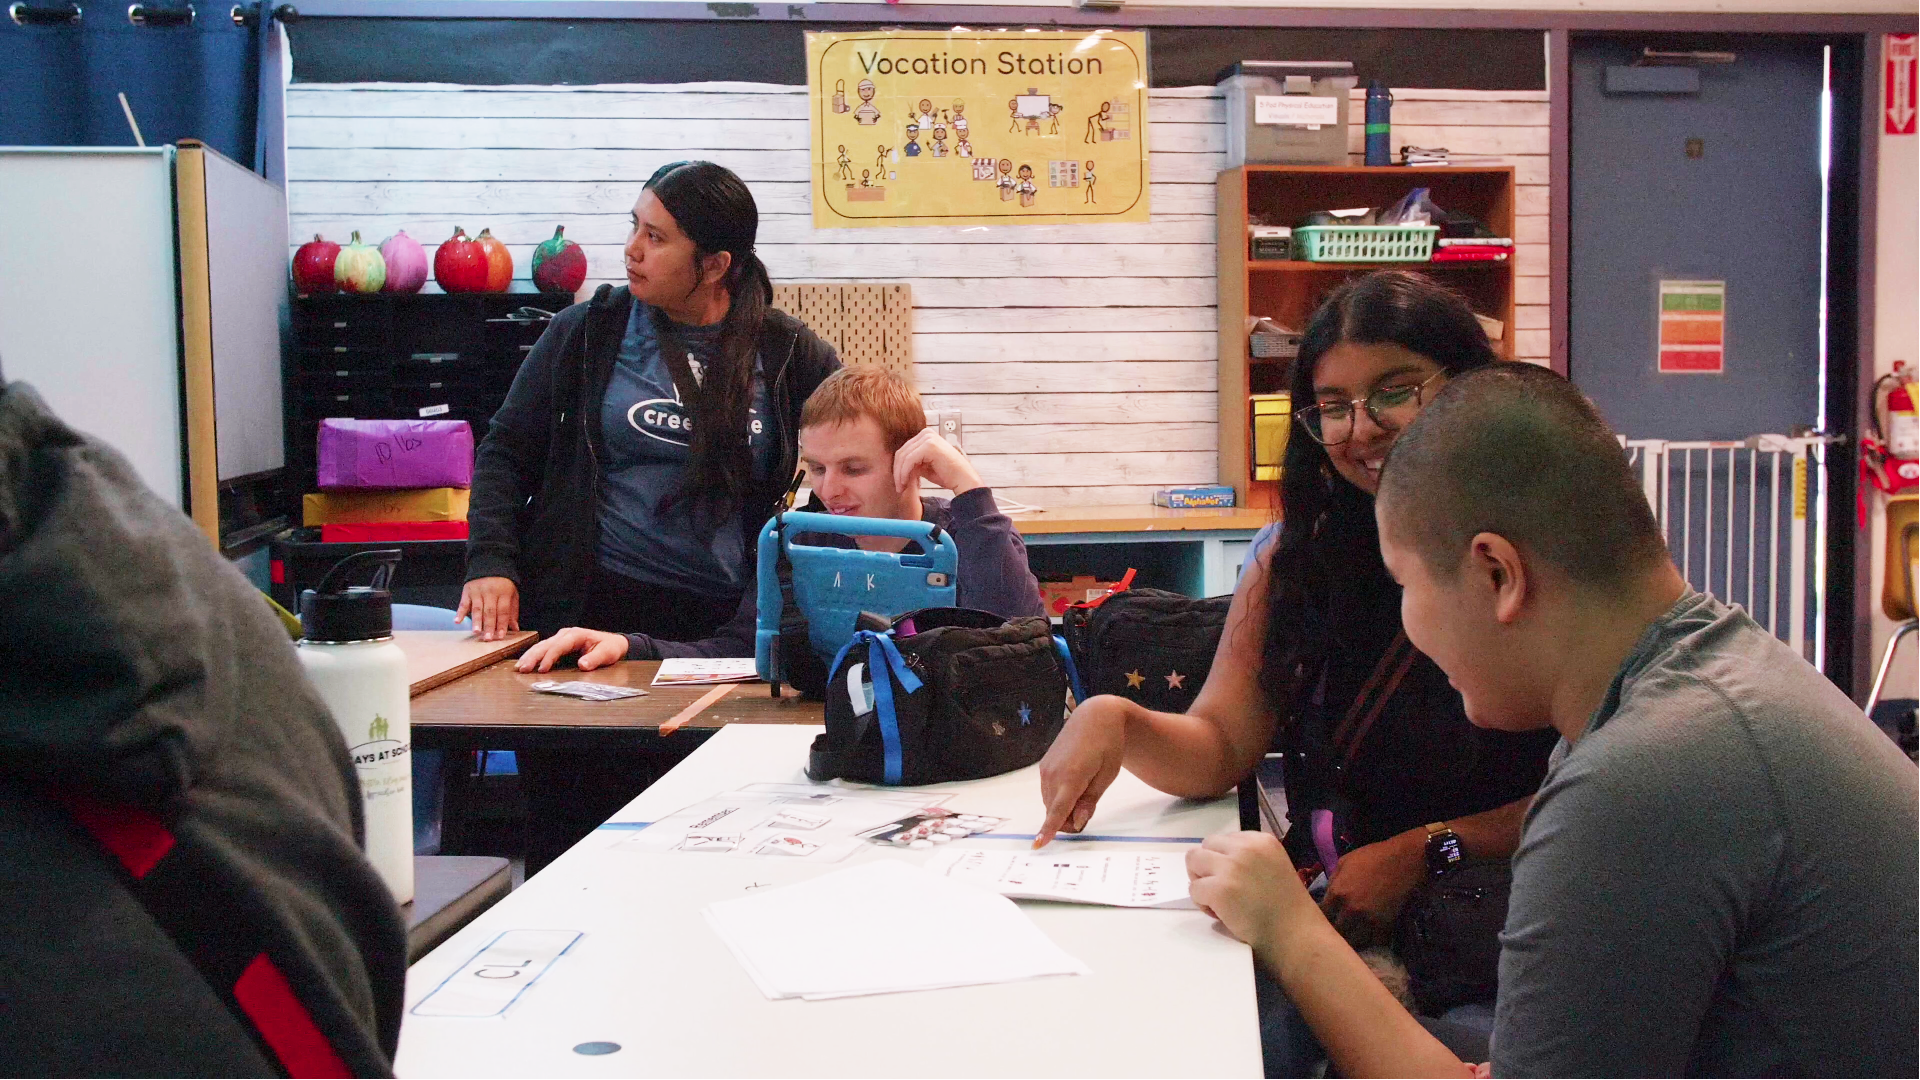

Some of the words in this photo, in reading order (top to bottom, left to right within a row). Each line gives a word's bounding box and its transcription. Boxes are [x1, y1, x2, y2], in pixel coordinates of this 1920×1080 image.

[857, 51, 986, 75] Vocation
[997, 51, 1102, 75] Station
[1278, 101, 1302, 110] Physical
[394, 434, 421, 453] lbs
[354, 754, 375, 764] AYS
[379, 752, 390, 761] AT
